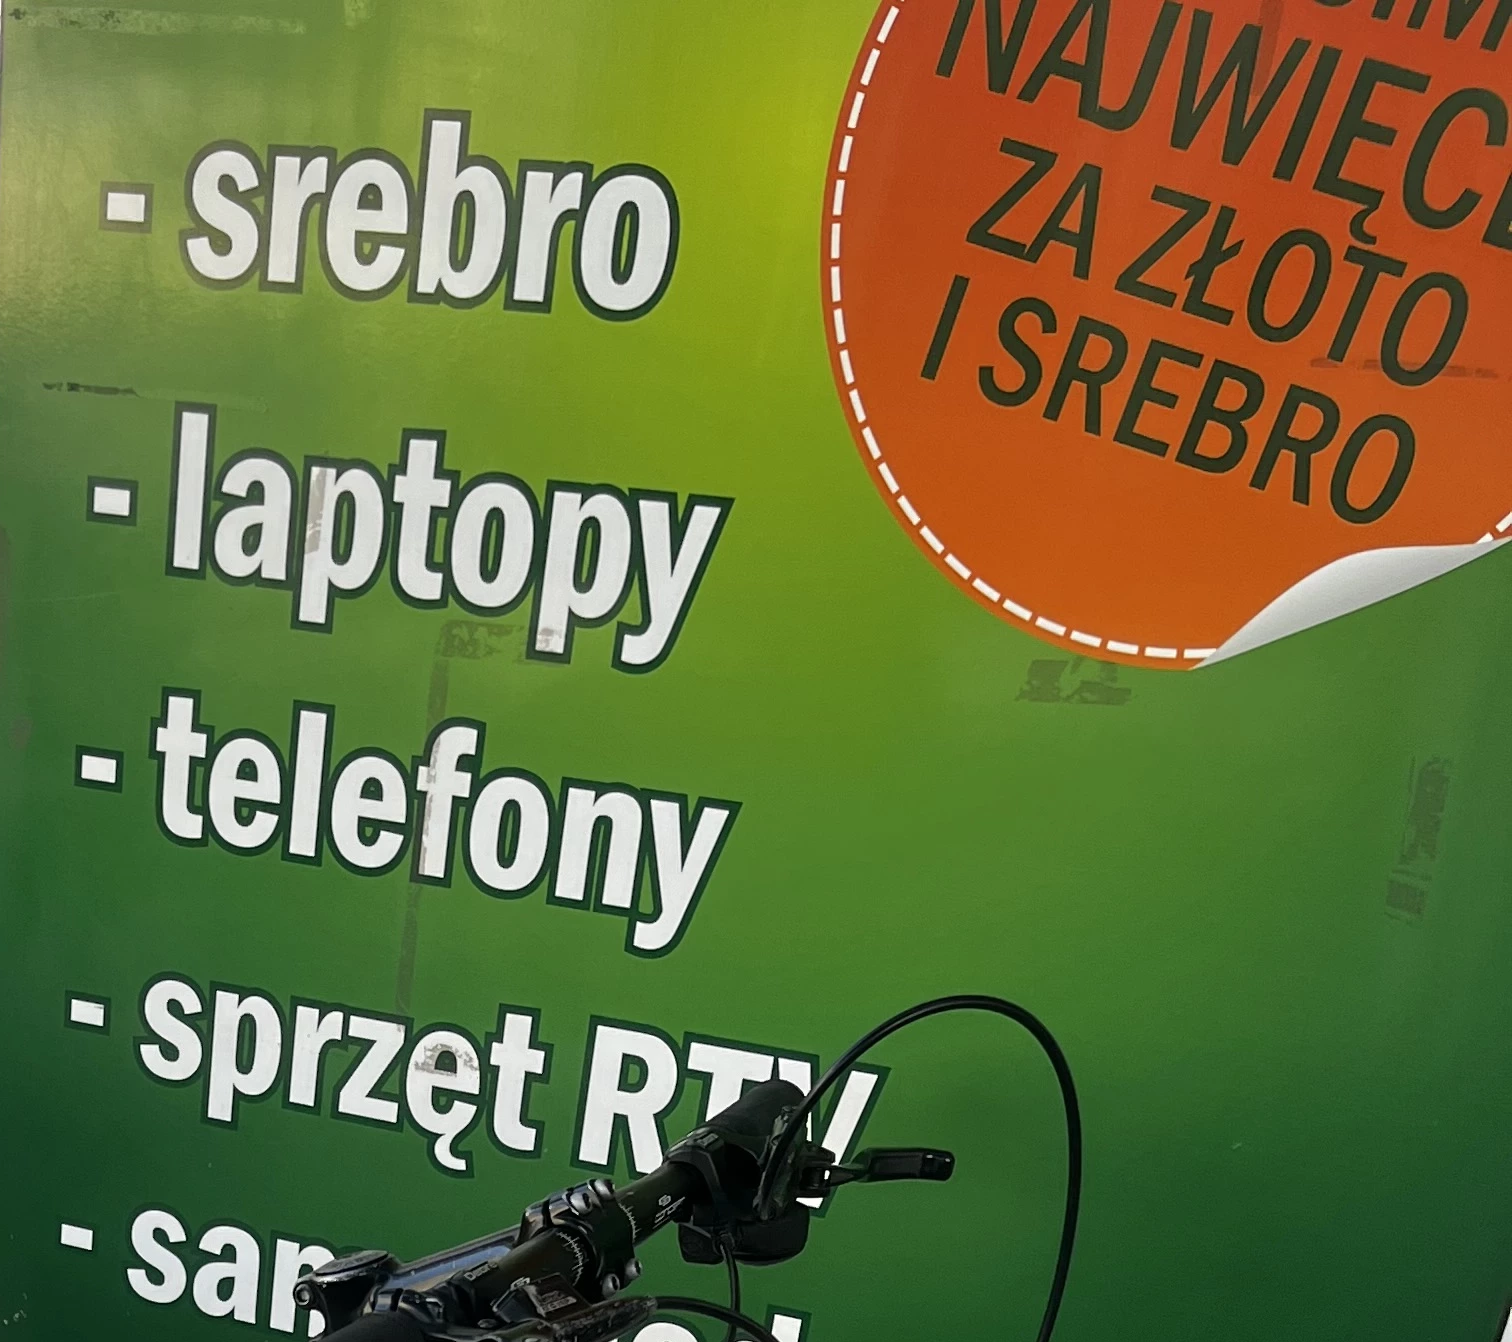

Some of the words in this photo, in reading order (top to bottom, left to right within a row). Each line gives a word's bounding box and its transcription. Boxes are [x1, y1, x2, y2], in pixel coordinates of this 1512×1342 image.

[186, 120, 672, 312] srebro
[936, 0, 1512, 252] NAJWIĘC
[967, 137, 1103, 280] ZA
[1115, 185, 1469, 387] ZŁOTO
[920, 274, 970, 381] I
[978, 297, 1416, 525] SREBRO
[172, 410, 722, 666] laptopy
[154, 696, 730, 952] telefony
[139, 979, 546, 1173] sprzęt
